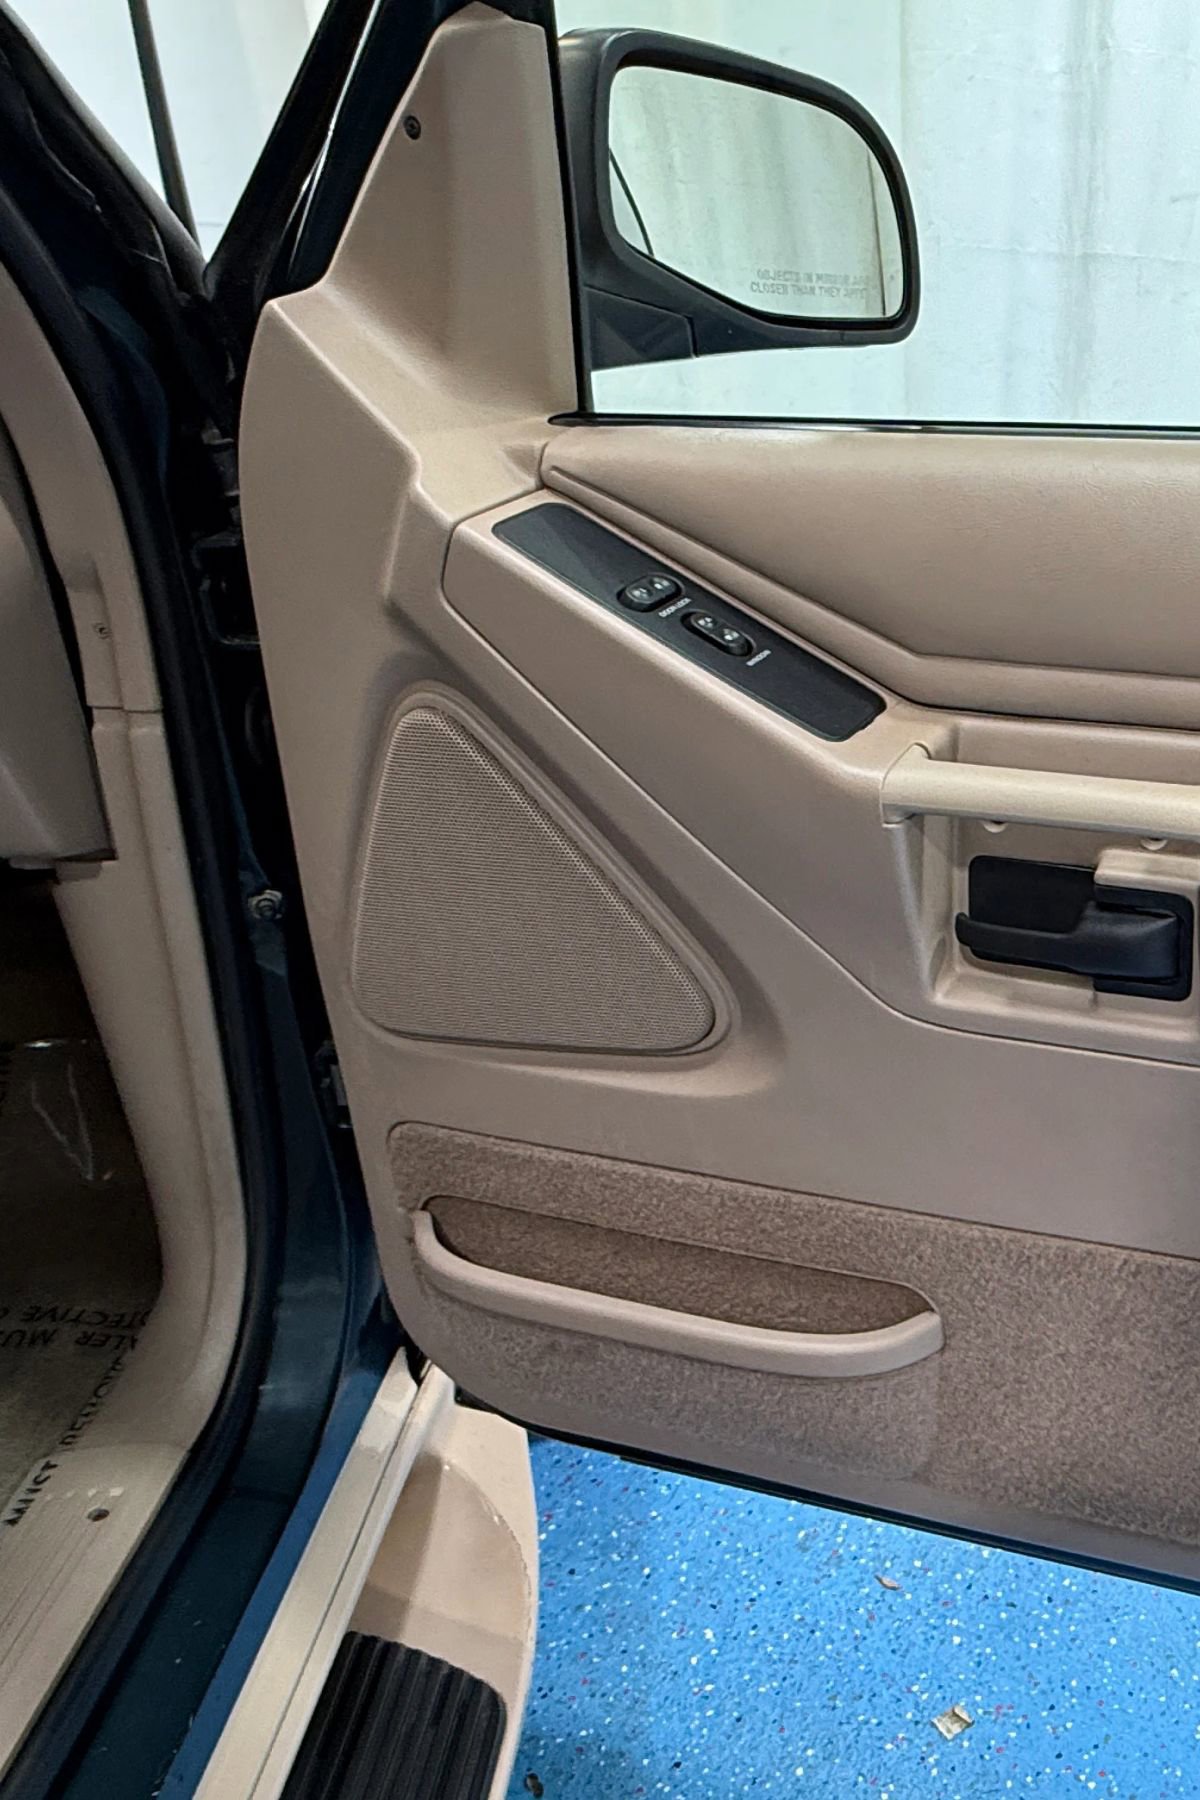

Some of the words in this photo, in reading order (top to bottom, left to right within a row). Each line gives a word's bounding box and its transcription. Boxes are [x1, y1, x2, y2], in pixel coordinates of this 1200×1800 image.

[757, 268, 799, 282] OBJECTS
[750, 281, 788, 296] CLOSER
[791, 284, 816, 297] THAN
[819, 286, 841, 298] THEY
